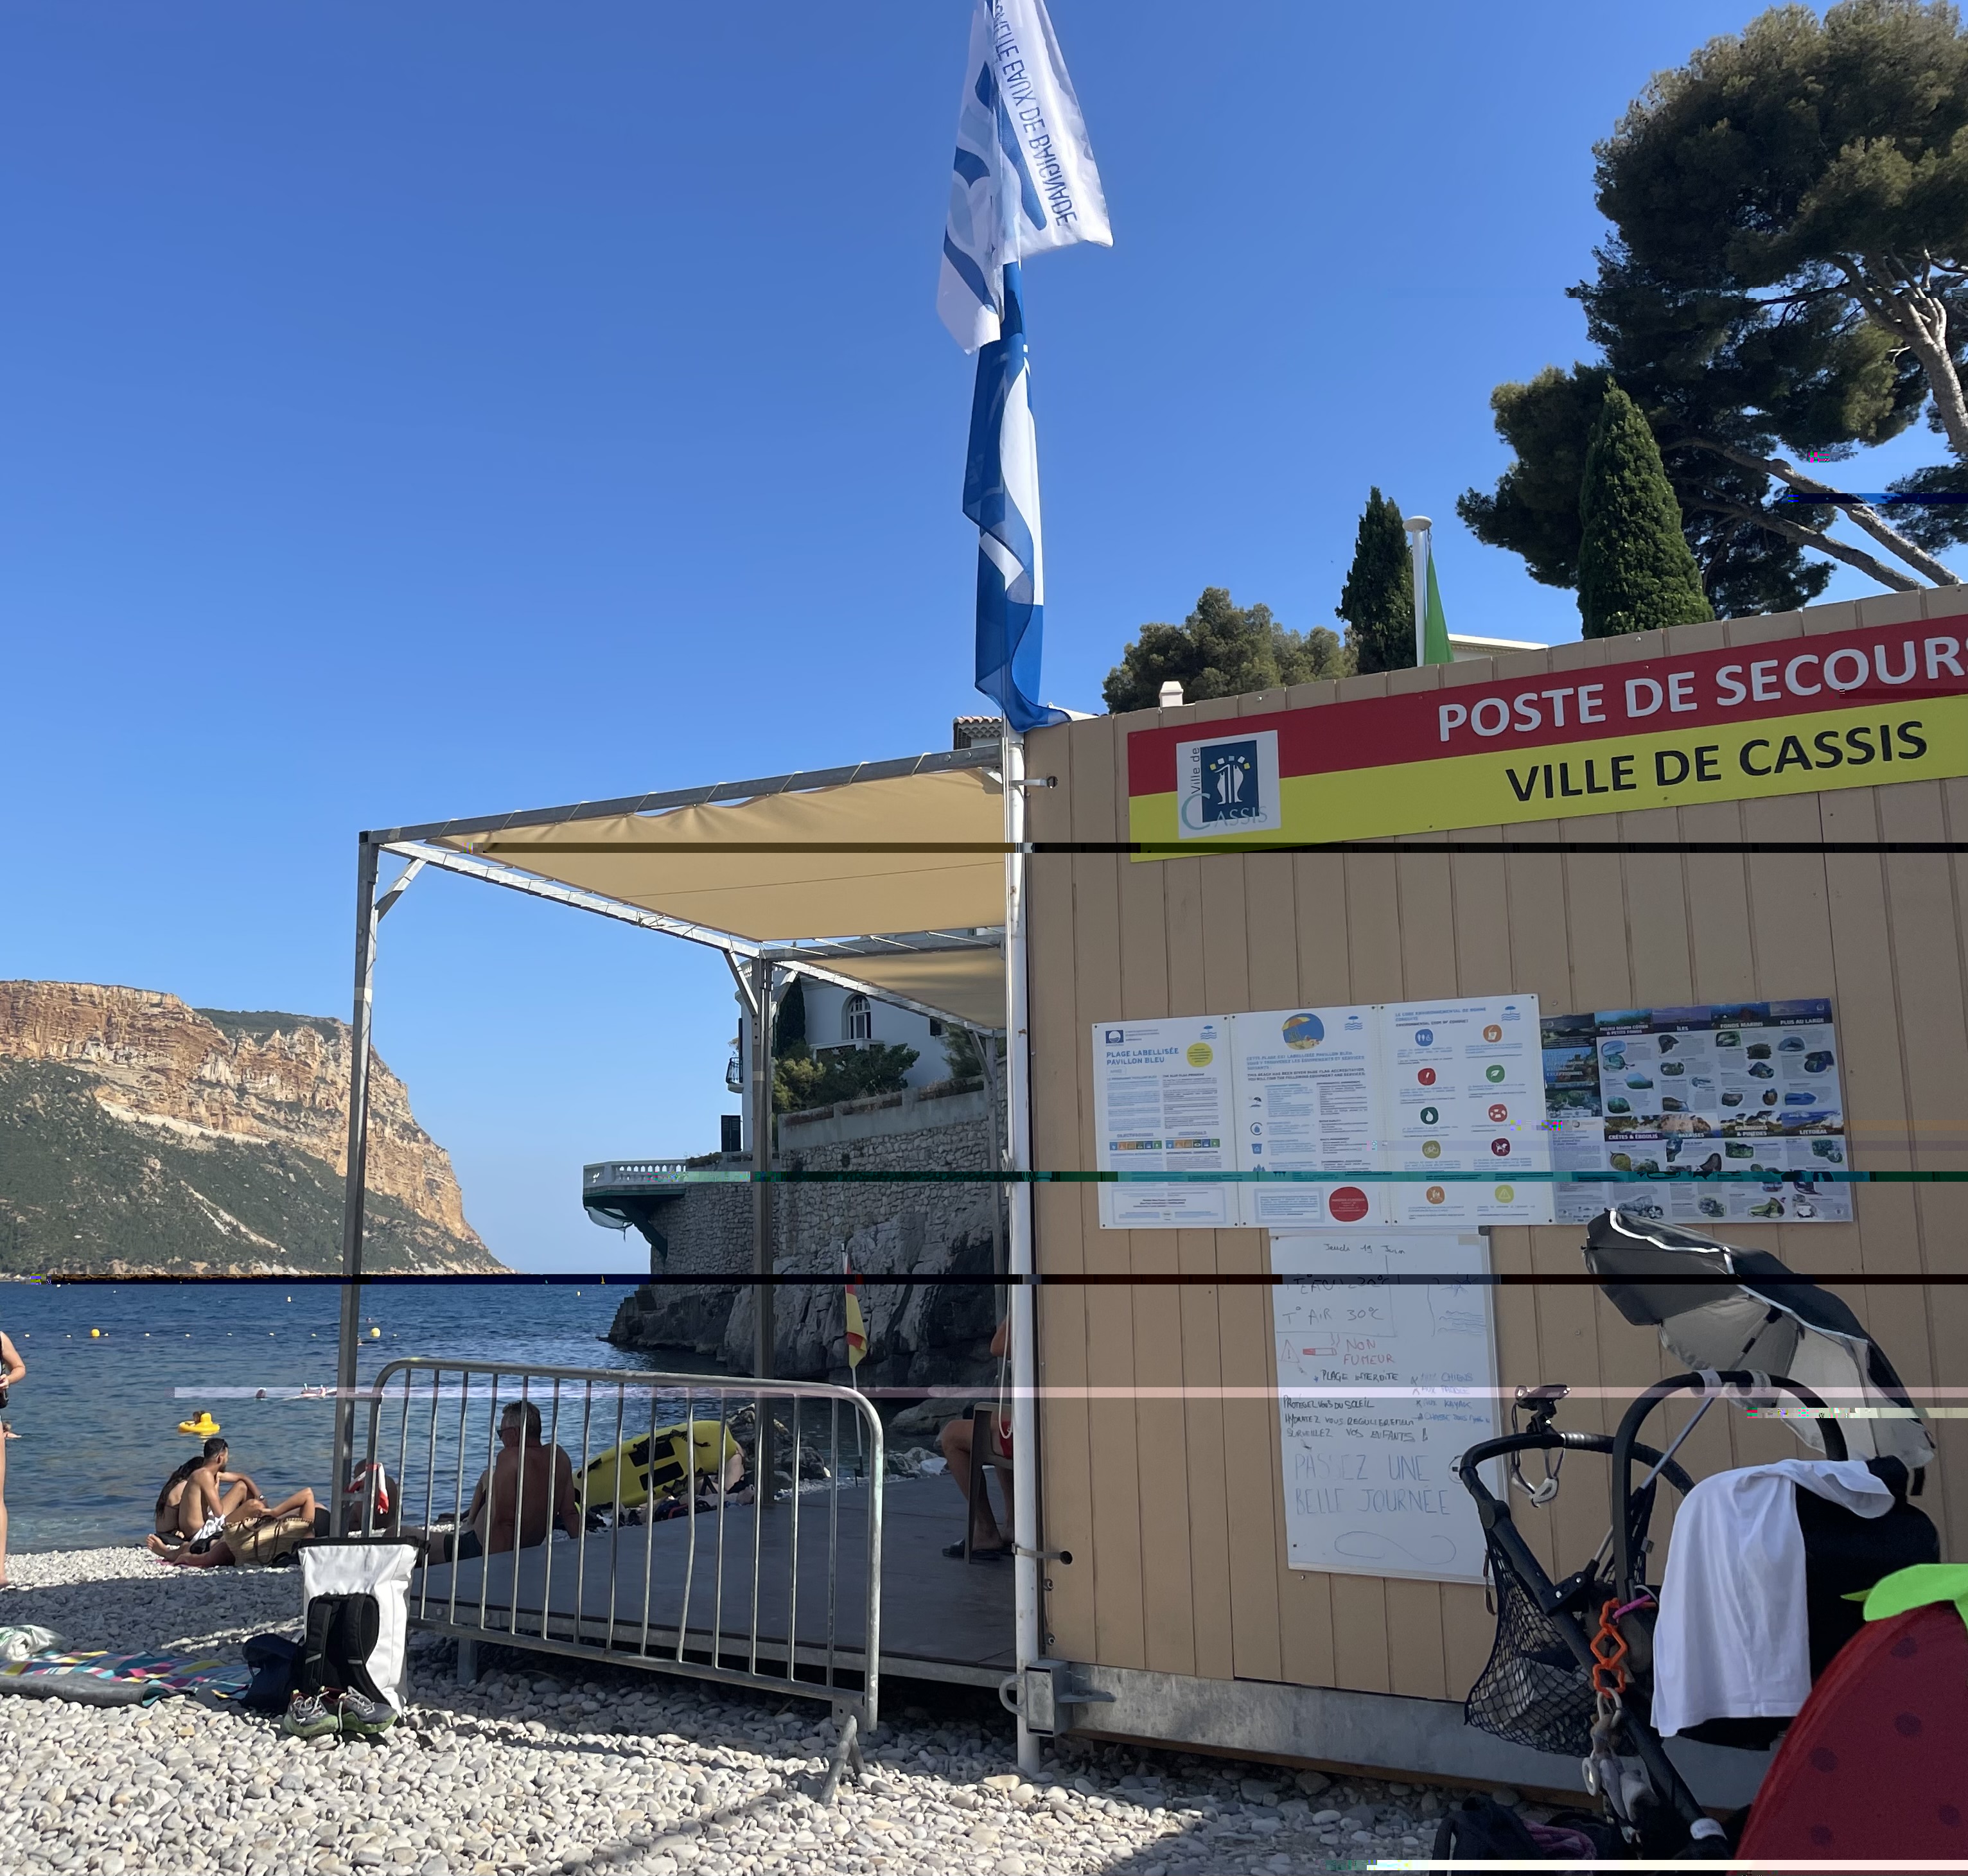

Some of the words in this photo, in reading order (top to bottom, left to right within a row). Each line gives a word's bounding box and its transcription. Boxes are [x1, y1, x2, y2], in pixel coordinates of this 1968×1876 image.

[1438, 683, 1606, 742] POSTE
[1624, 671, 1698, 718] DE
[1716, 636, 1968, 707] SECOUR
[1190, 747, 1200, 762] de
[1505, 755, 1637, 802] VILLE
[1655, 744, 1722, 787] DE
[1739, 721, 1928, 777] CASSIS
[1190, 767, 1201, 794] Ville
[1181, 793, 1268, 830] CASSIS
[1106, 1049, 1130, 1058] PLAGE
[1132, 1046, 1180, 1057] LABELLISÉE
[1346, 1338, 1376, 1351] NON
[1343, 1353, 1395, 1366] FUMEUR
[1321, 1369, 1348, 1382] PLAGE
[1444, 1399, 1473, 1410] KAYAK
[1324, 1416, 1344, 1426] VOUS
[1346, 1428, 1364, 1438] VOS
[1370, 1430, 1416, 1442] ENFANTS
[1295, 1453, 1369, 1480] PASSEZ
[1388, 1453, 1430, 1481] UNE
[1296, 1487, 1345, 1516] BELLE
[1356, 1485, 1451, 1516] JOURNÉE
